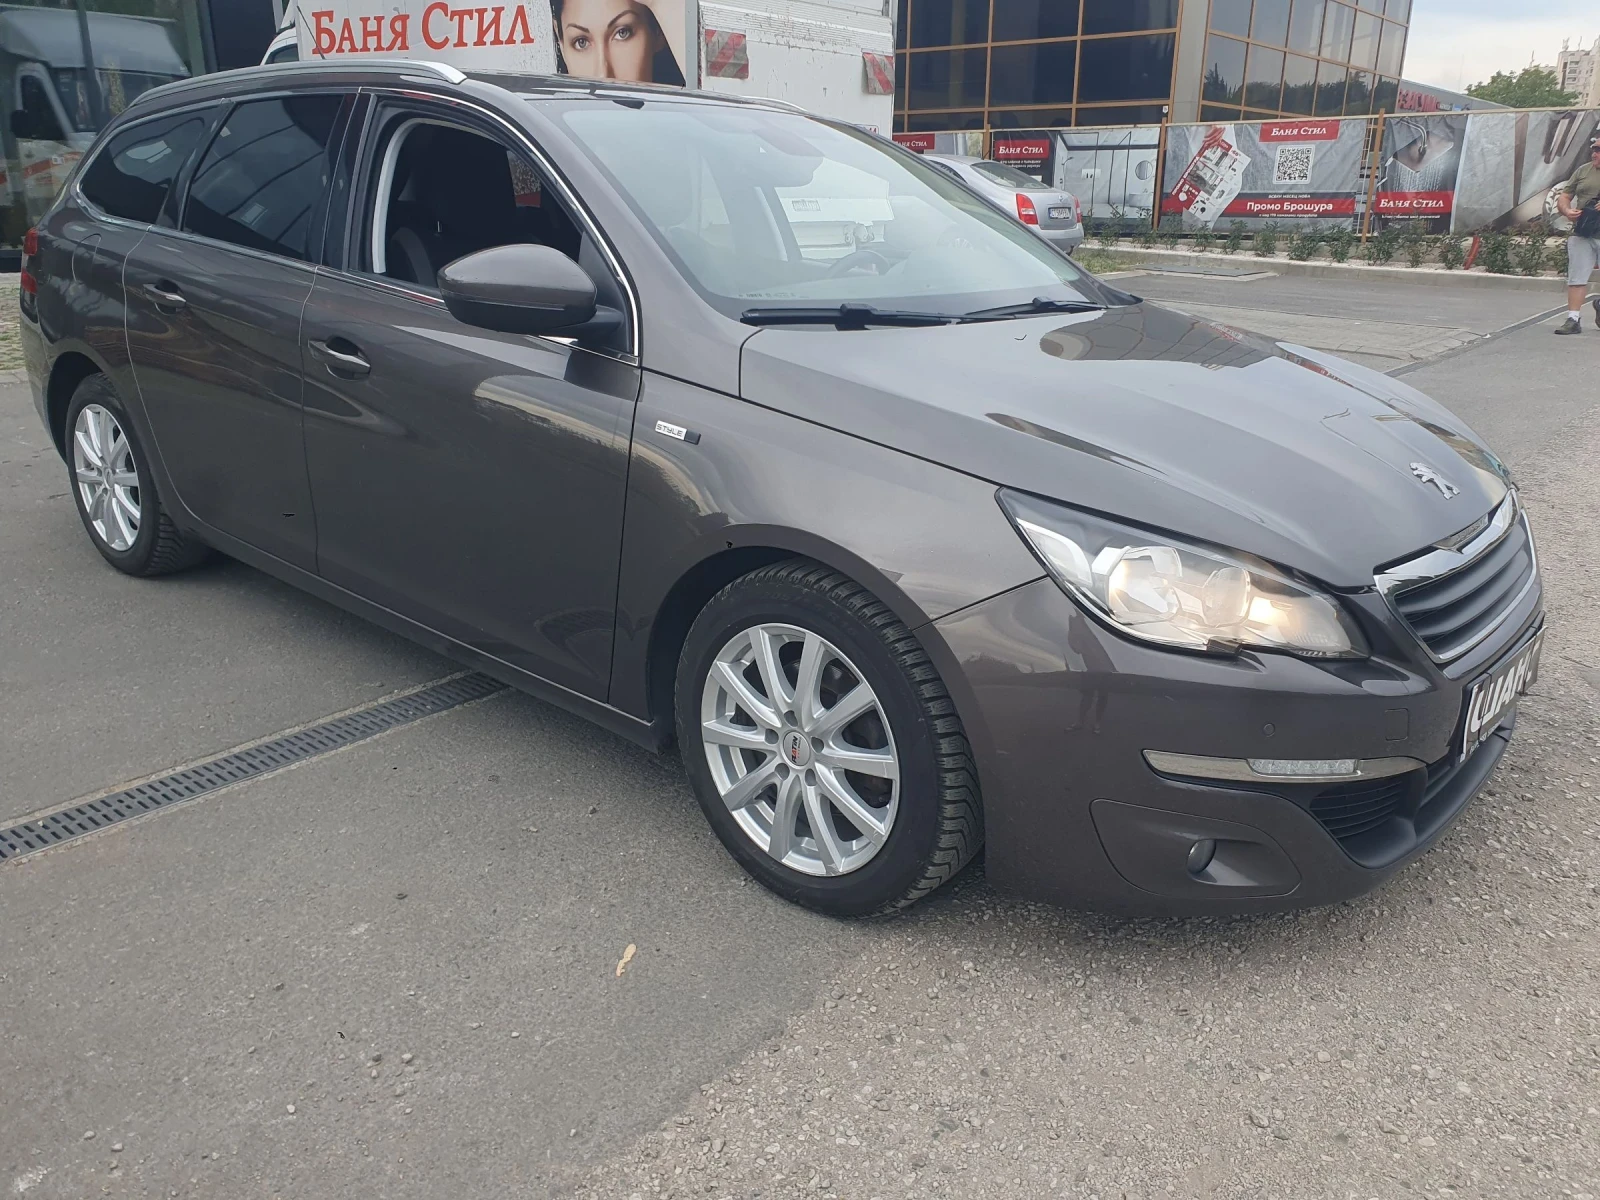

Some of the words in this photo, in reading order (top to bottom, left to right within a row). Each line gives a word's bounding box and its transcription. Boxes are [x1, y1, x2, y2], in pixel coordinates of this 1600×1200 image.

[1247, 201, 1281, 212] Промо
[1283, 201, 1334, 212] Брошура
[656, 423, 684, 437] STYLE
